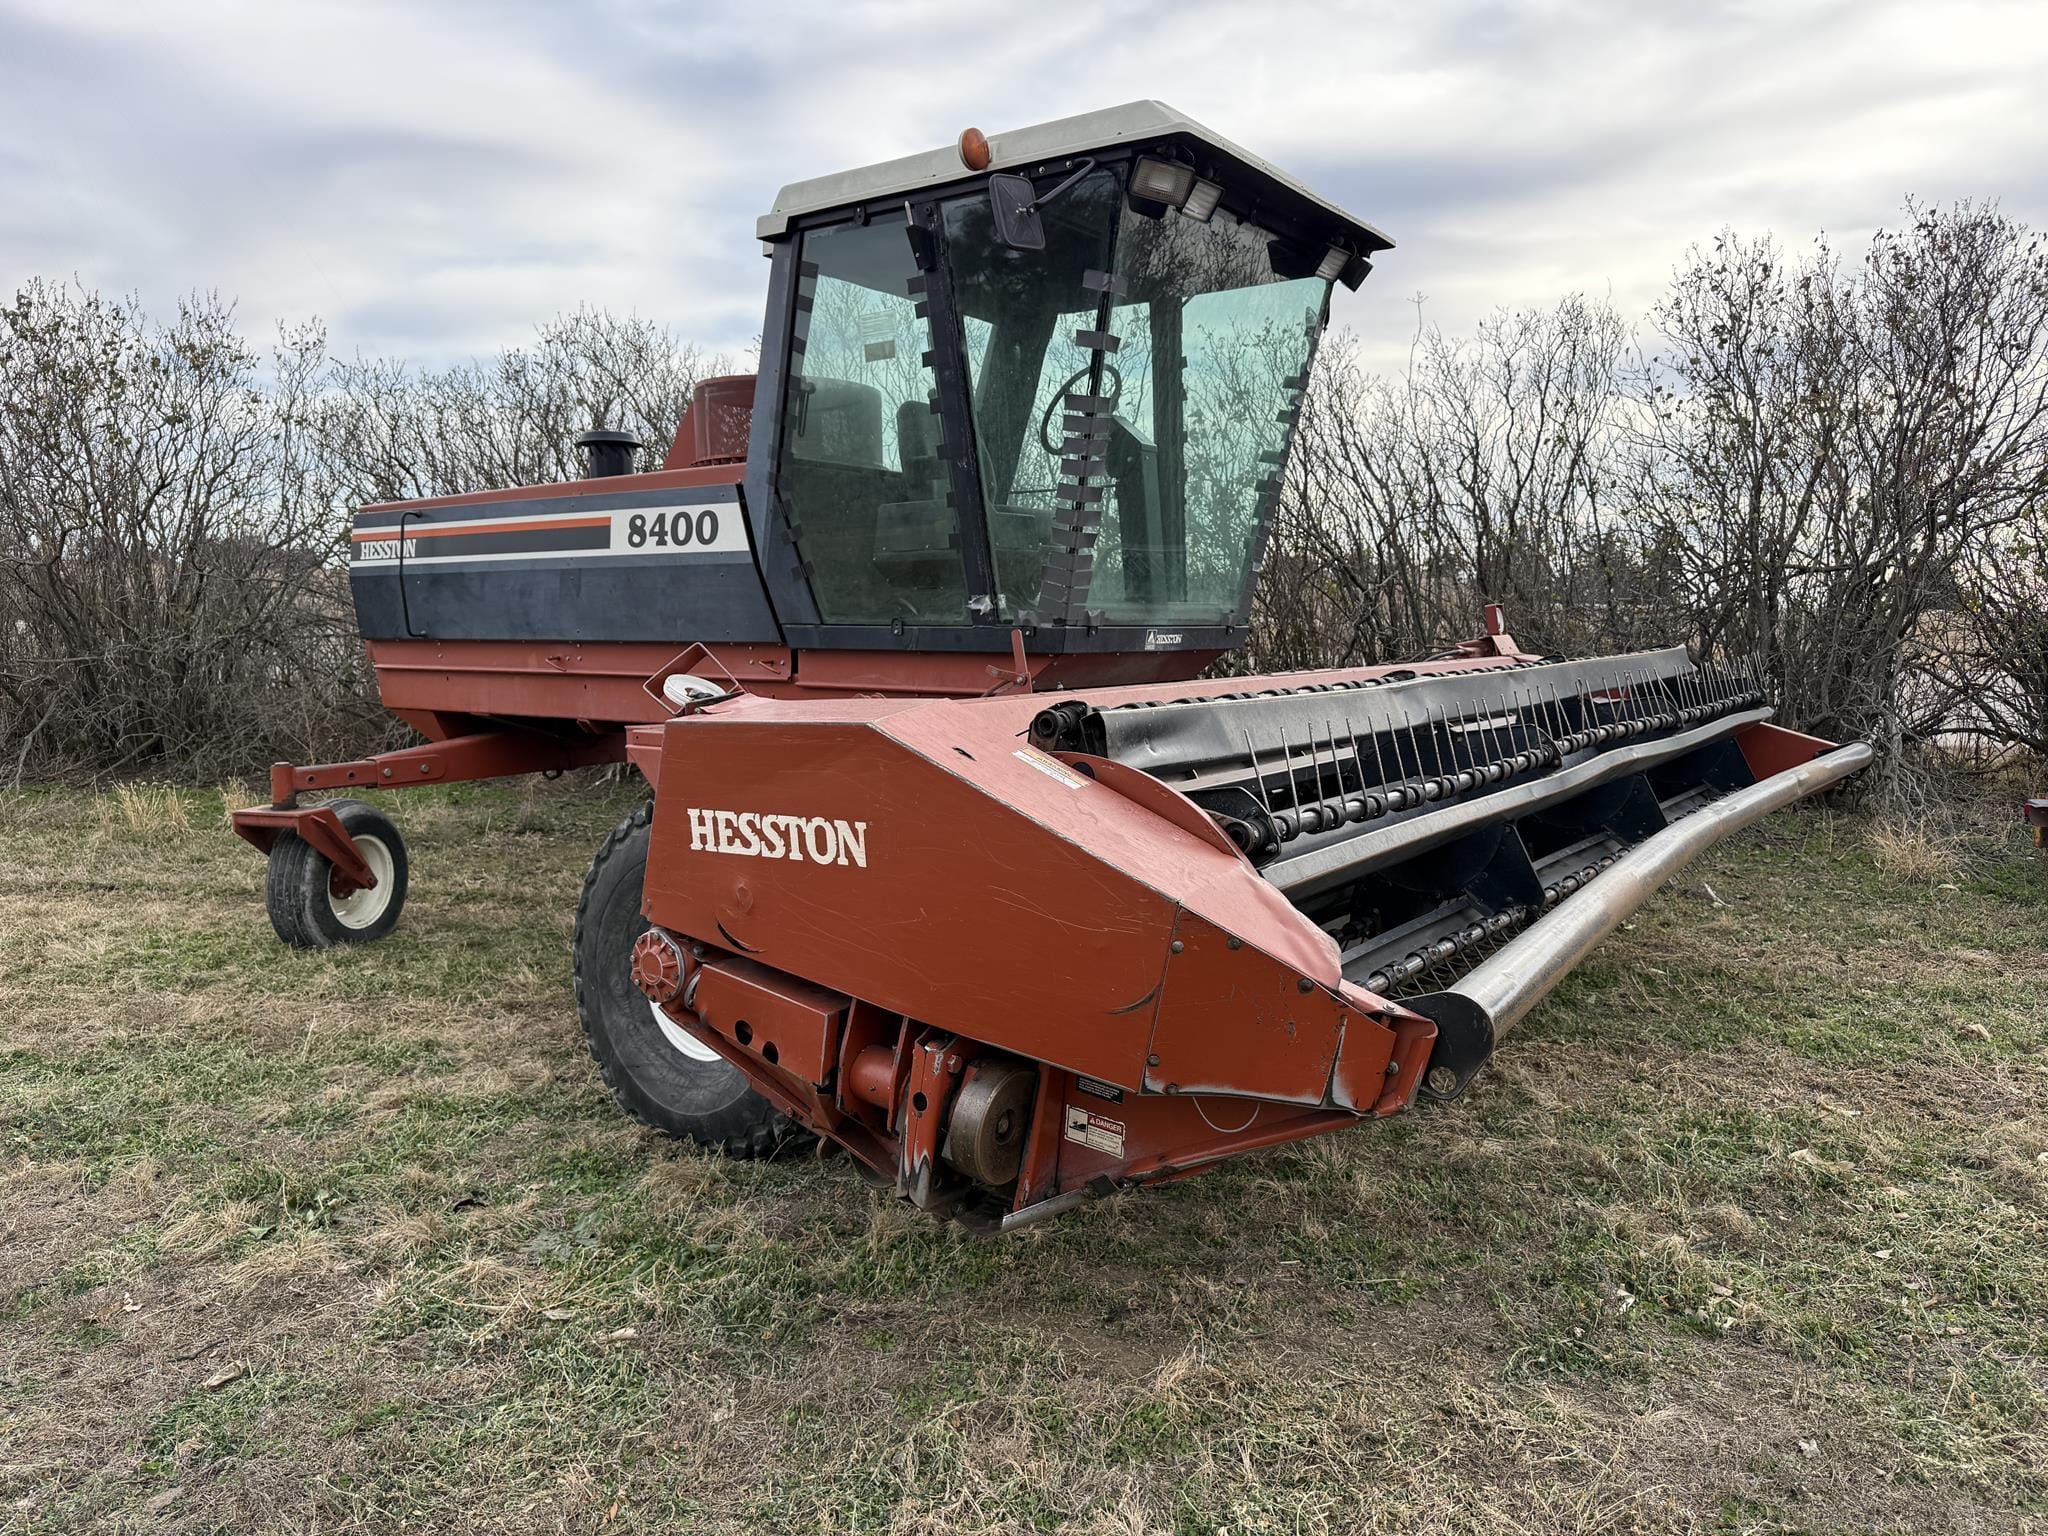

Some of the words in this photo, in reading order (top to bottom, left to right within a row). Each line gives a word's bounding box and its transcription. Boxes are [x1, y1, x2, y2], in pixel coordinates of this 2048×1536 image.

[628, 510, 719, 548] 8400
[360, 539, 416, 559] HESSTON
[687, 808, 867, 868] HESSTON
[1096, 1118, 1122, 1133] DANGER
